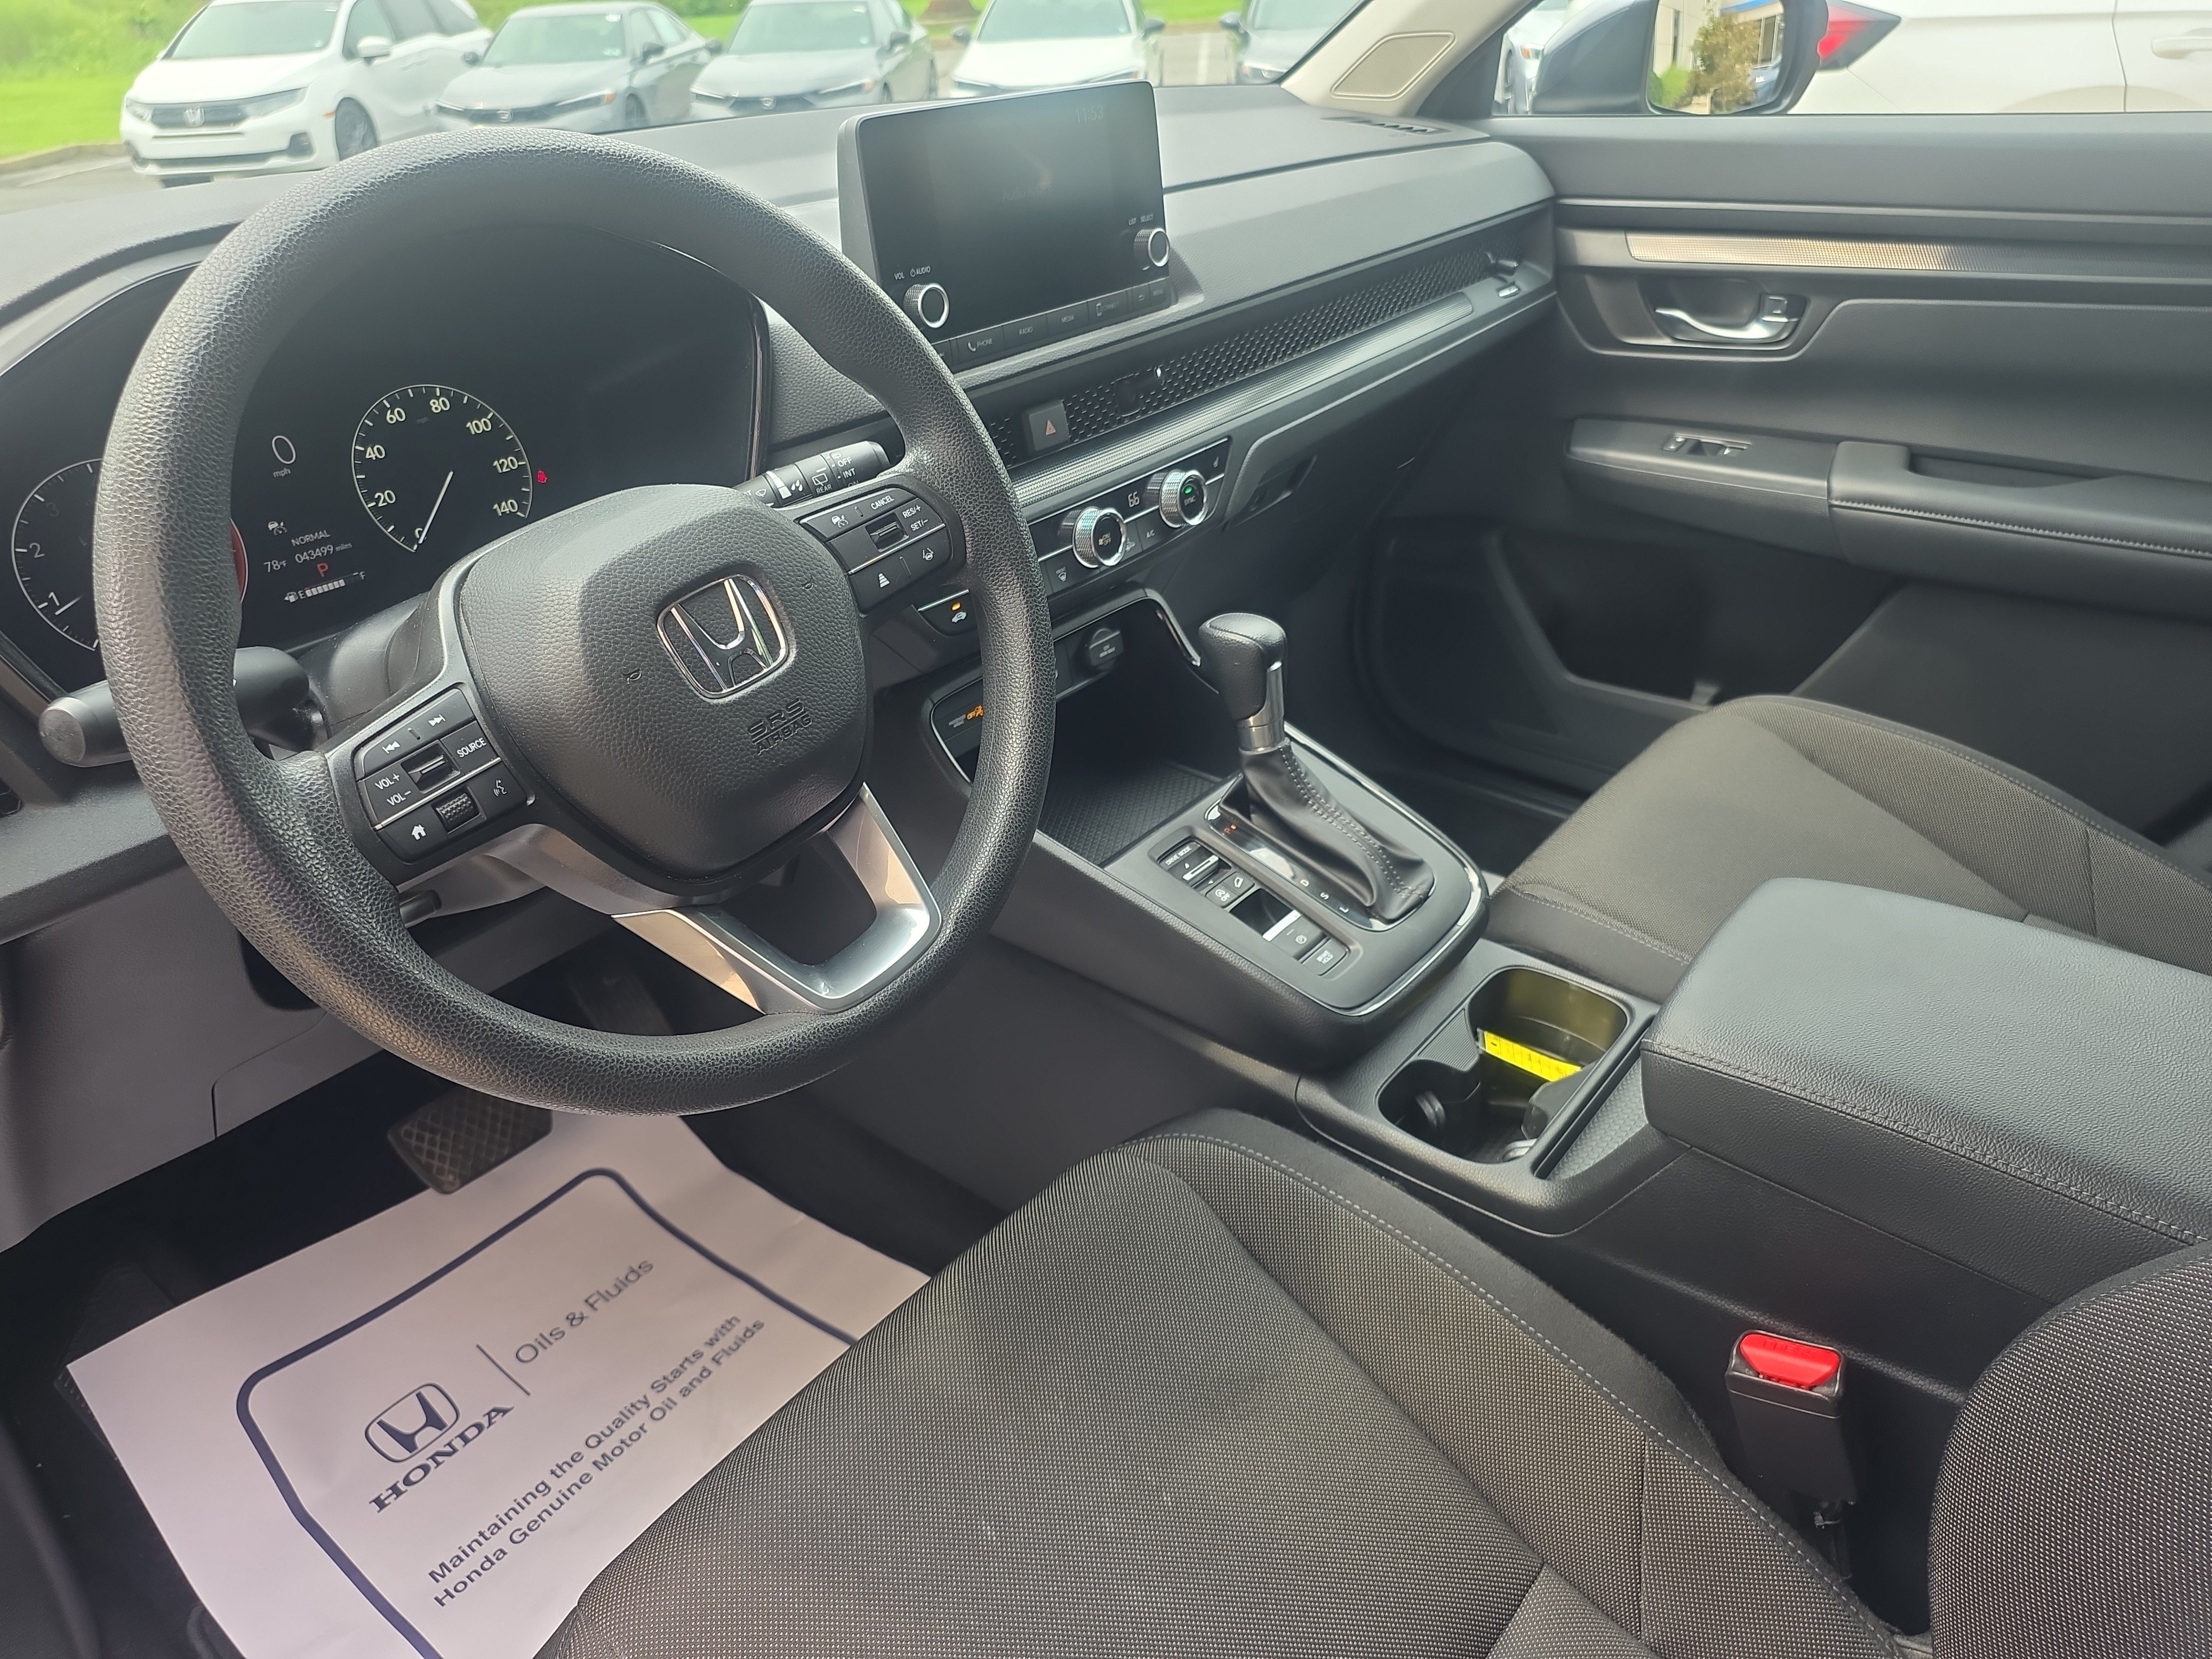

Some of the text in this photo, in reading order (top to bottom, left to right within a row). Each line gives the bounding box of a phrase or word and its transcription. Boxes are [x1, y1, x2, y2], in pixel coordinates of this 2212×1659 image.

[894, 266, 931, 280] VOL AUDIO
[1019, 327, 1033, 336] RADIO
[977, 338, 993, 349] PHONE
[429, 397, 451, 413] 80
[386, 408, 406, 424] 60
[466, 417, 492, 435] 100
[272, 435, 296, 465] 0
[365, 445, 386, 460] 40
[492, 456, 518, 473] 120
[837, 456, 852, 468] OFF
[273, 467, 291, 478] mph
[843, 468, 856, 479] INT
[816, 484, 833, 494] REAR
[374, 490, 396, 507] 20
[870, 495, 895, 510] CANCEL
[1128, 491, 1140, 508] 66
[492, 499, 518, 517] 140
[902, 505, 921, 519] RES/+
[291, 530, 331, 547] NORMAL
[1103, 538, 1112, 546] OFF
[29, 542, 45, 558] 2
[294, 544, 334, 564] 043499
[317, 562, 329, 577] P
[359, 571, 366, 580] F
[48, 591, 60, 606] 1
[298, 590, 307, 600] E
[748, 698, 805, 741] SRS
[456, 737, 487, 758] SOURCE
[375, 773, 401, 790] VOL+
[1178, 846, 1192, 857] MODE
[1321, 954, 1333, 964] HOLD
[516, 1260, 654, 1363] Oils & Fluids
[428, 1315, 741, 1584] Maintaining the Quality Starts with
[369, 1405, 515, 1513] HONDA
[434, 1320, 764, 1607] Honda Genuine Motor Oil and Fluids
